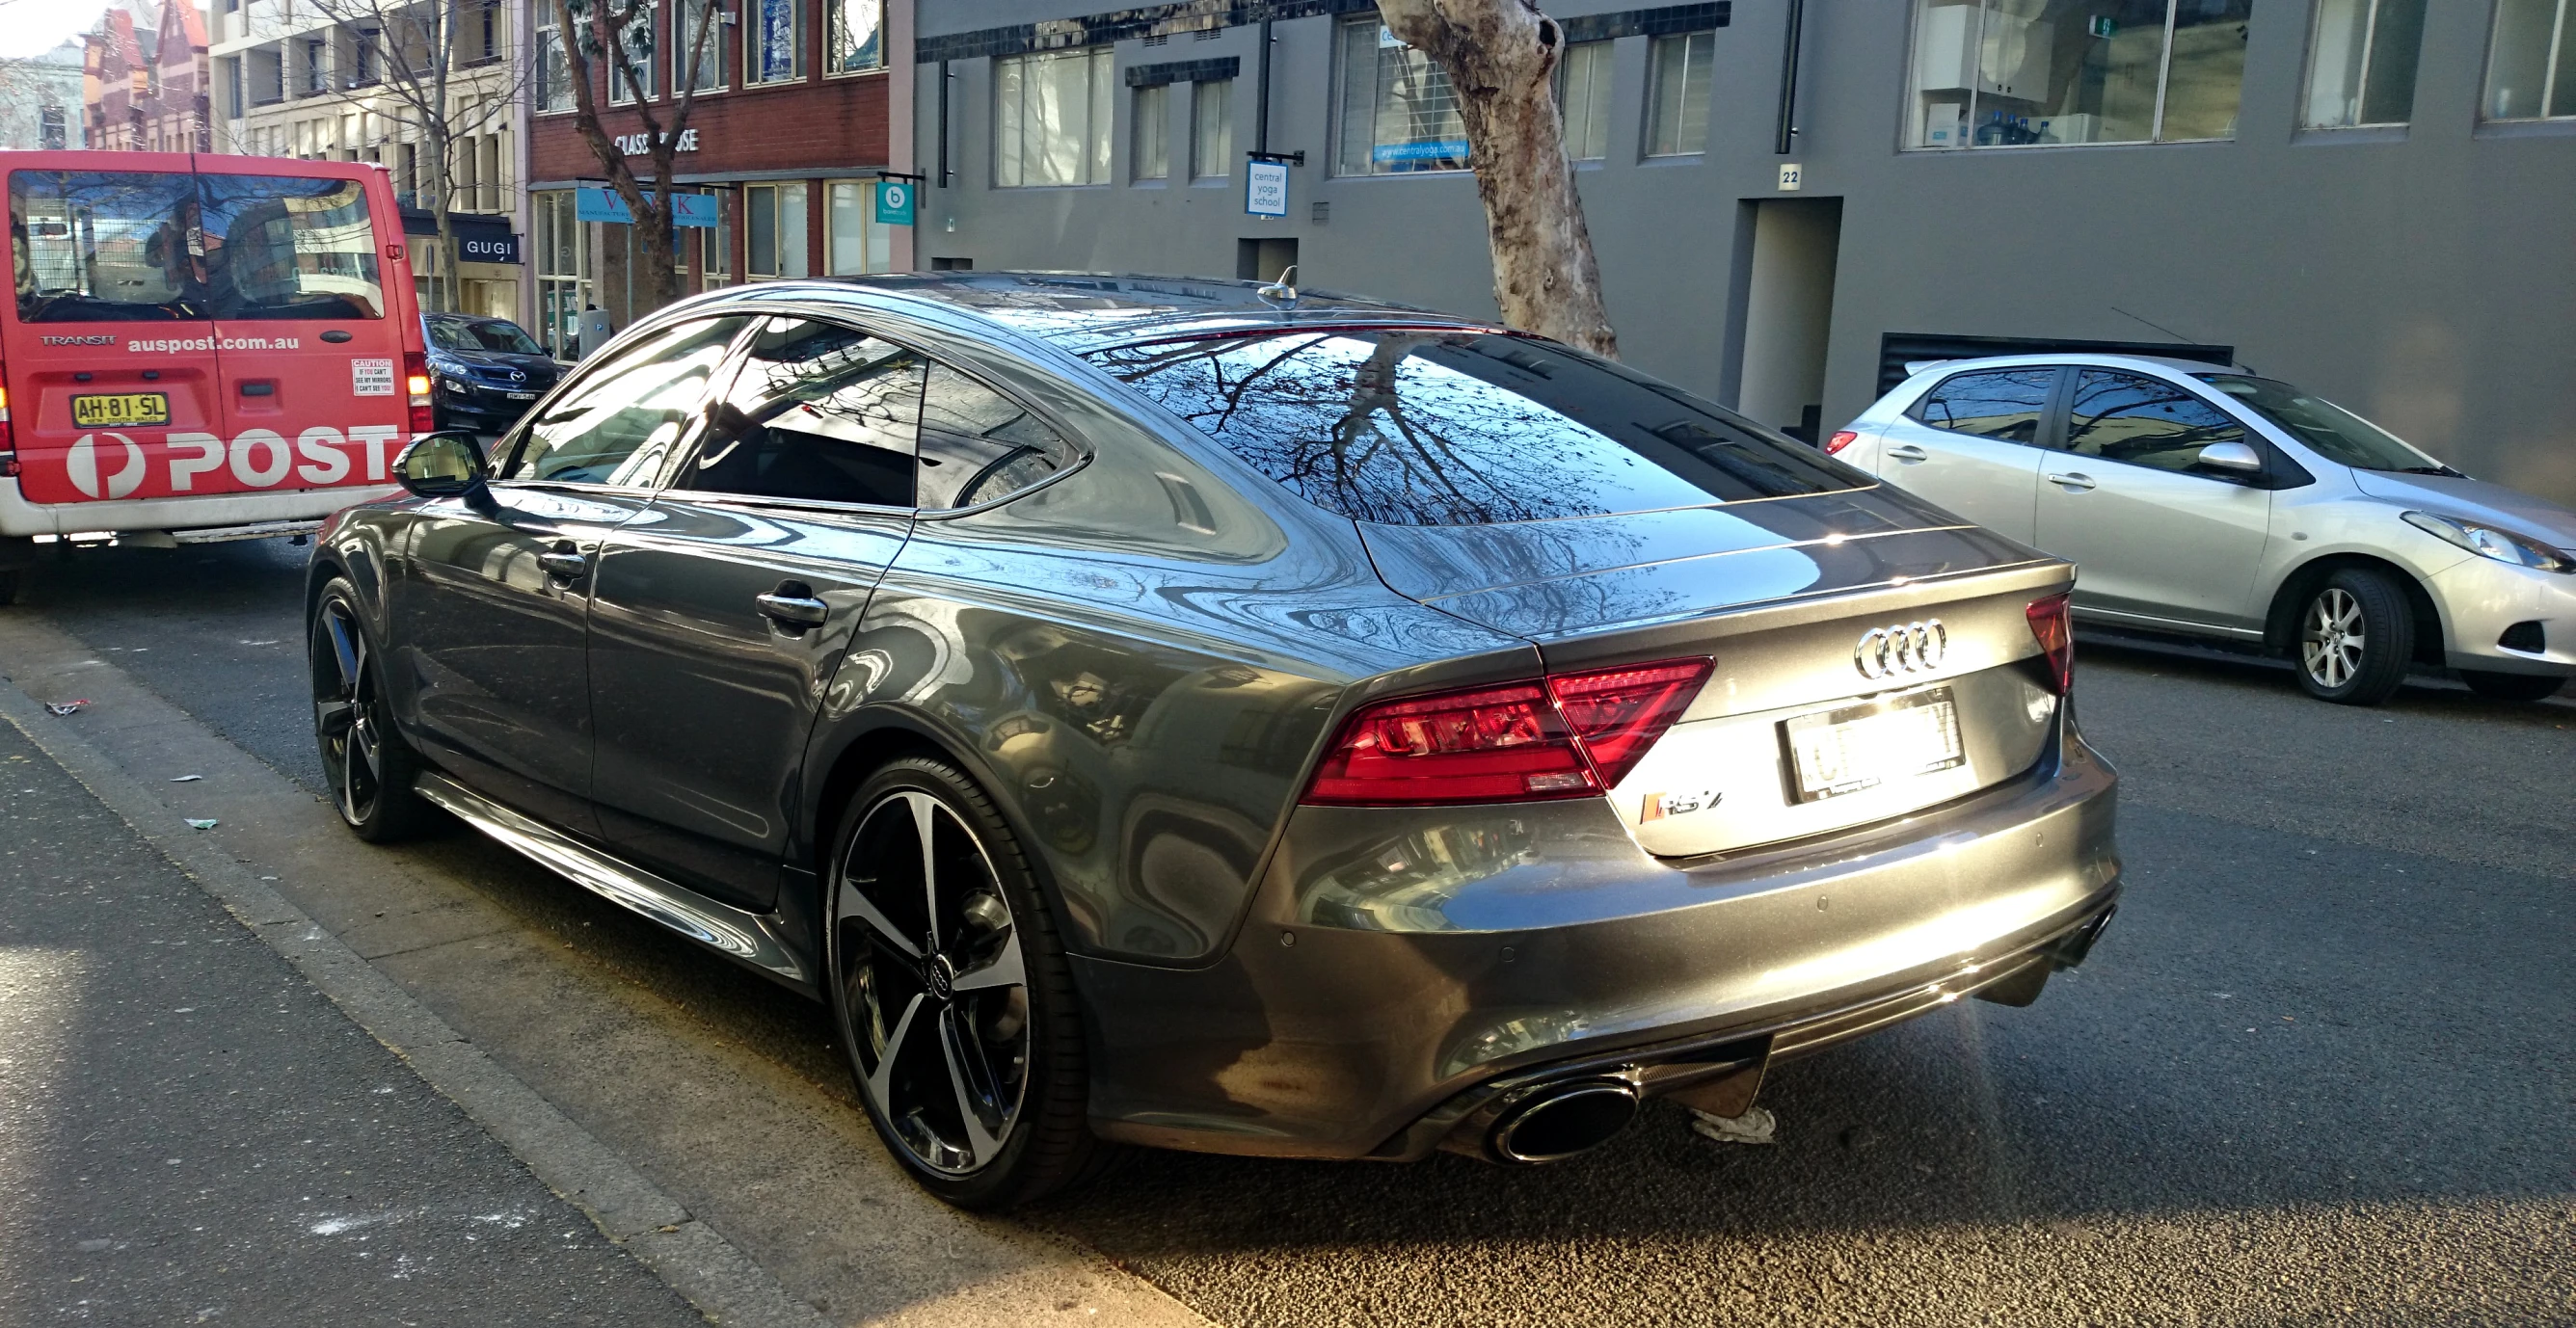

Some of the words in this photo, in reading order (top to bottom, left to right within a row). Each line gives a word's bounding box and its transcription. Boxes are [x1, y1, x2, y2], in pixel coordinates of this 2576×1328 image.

[1382, 145, 1465, 156] www.centralyoga.com.au
[1254, 173, 1282, 182] central
[1784, 172, 1798, 183] 22
[1257, 185, 1278, 196] yoga
[1253, 197, 1280, 207] school
[467, 241, 511, 255] GUGI
[40, 335, 117, 346] TRANSIT
[128, 336, 299, 354] auspost.com.au
[165, 425, 399, 491] POST
